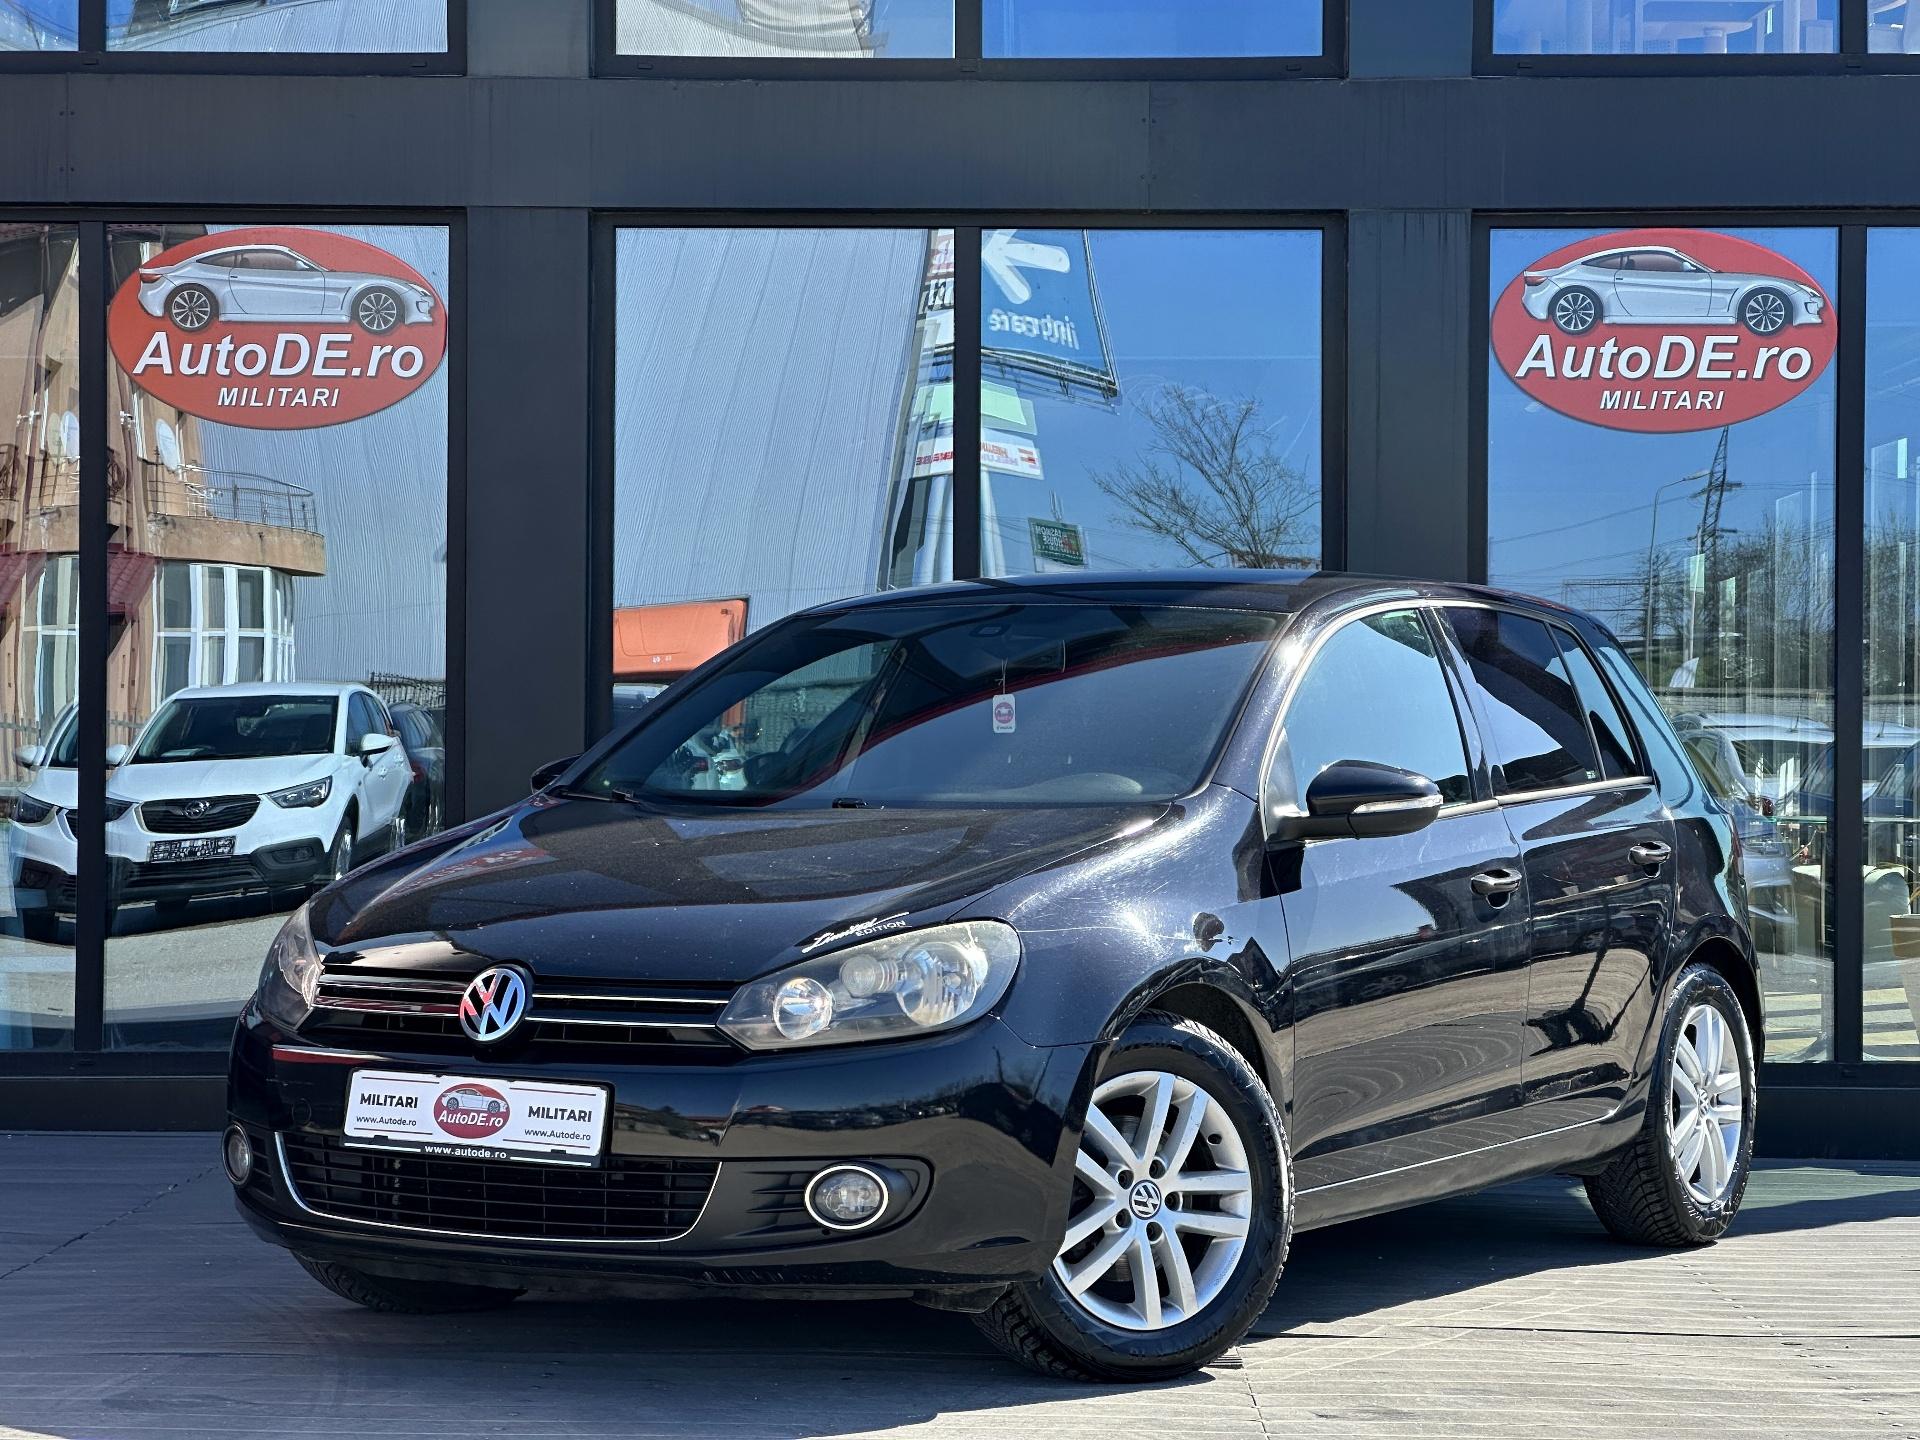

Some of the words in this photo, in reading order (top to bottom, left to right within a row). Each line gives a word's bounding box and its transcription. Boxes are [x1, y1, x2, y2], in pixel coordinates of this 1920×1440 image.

[132, 331, 423, 378] AutoDE.ro
[1515, 334, 1812, 381] AutoDE.ro
[217, 387, 339, 407] MILITARI
[1600, 390, 1725, 410] MILITARI
[855, 920, 907, 937] EDITION
[359, 1093, 418, 1109] MILITARI
[356, 1116, 417, 1127] www.Autode.ro
[437, 1109, 504, 1128] AutoDE.ro
[528, 1105, 592, 1123] MILITARI
[524, 1128, 591, 1141] www.Autode.ro
[424, 1144, 507, 1159] www.autode.ro
